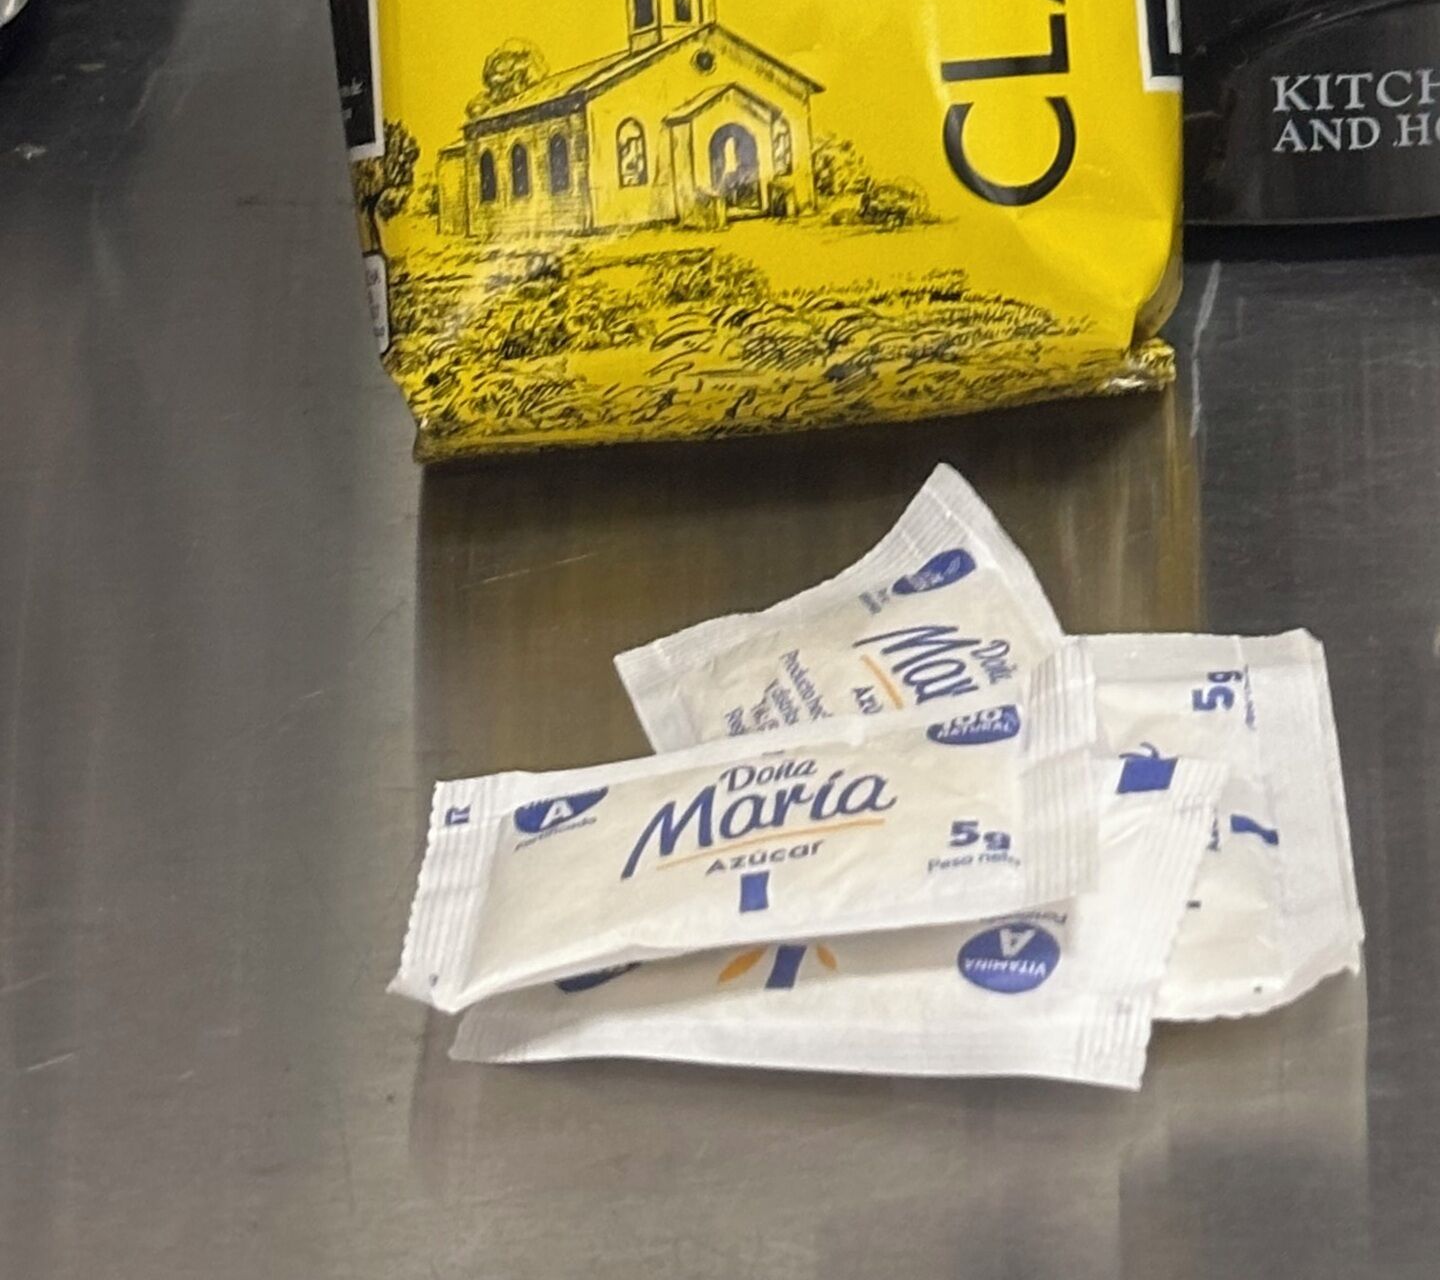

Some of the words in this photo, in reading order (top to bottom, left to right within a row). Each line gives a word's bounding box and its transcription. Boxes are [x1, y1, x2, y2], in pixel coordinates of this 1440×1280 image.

[1272, 115, 1381, 153] AND
[851, 625, 983, 705] Mar
[1191, 669, 1244, 712] 5g
[719, 750, 818, 792] Doña
[620, 770, 899, 881] María
[948, 820, 1011, 851] 5g
[705, 838, 825, 876] Azúcar
[999, 927, 1037, 958] A
[964, 958, 1048, 978] VITAMINA
